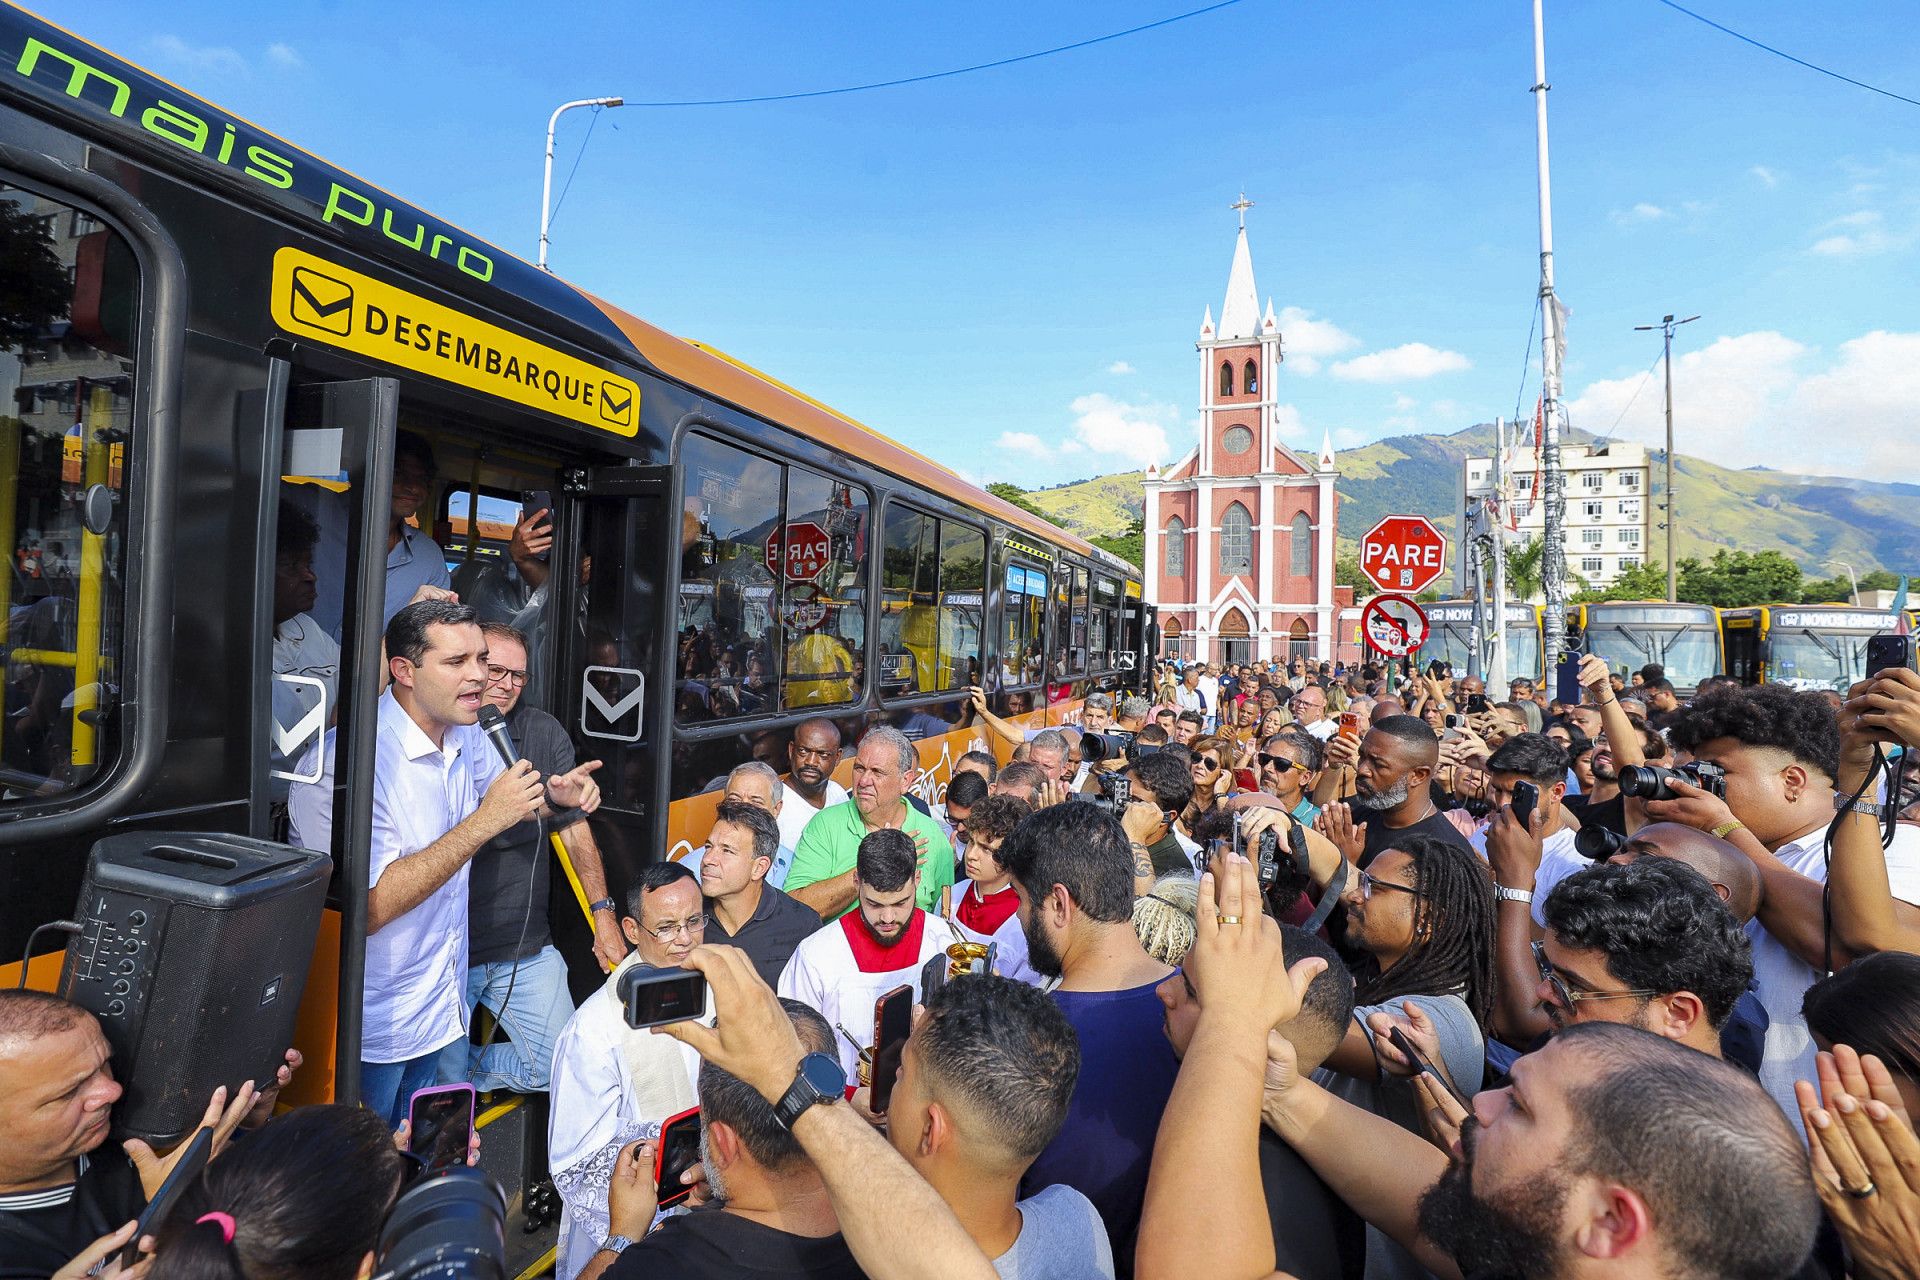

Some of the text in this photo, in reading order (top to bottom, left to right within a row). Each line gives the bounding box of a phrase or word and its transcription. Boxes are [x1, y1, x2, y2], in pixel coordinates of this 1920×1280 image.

[16, 37, 493, 282] mais puro
[364, 303, 595, 407] DESEMBARQUE
[1366, 543, 1439, 567] PARE
[1800, 612, 1846, 627] NOVOS
